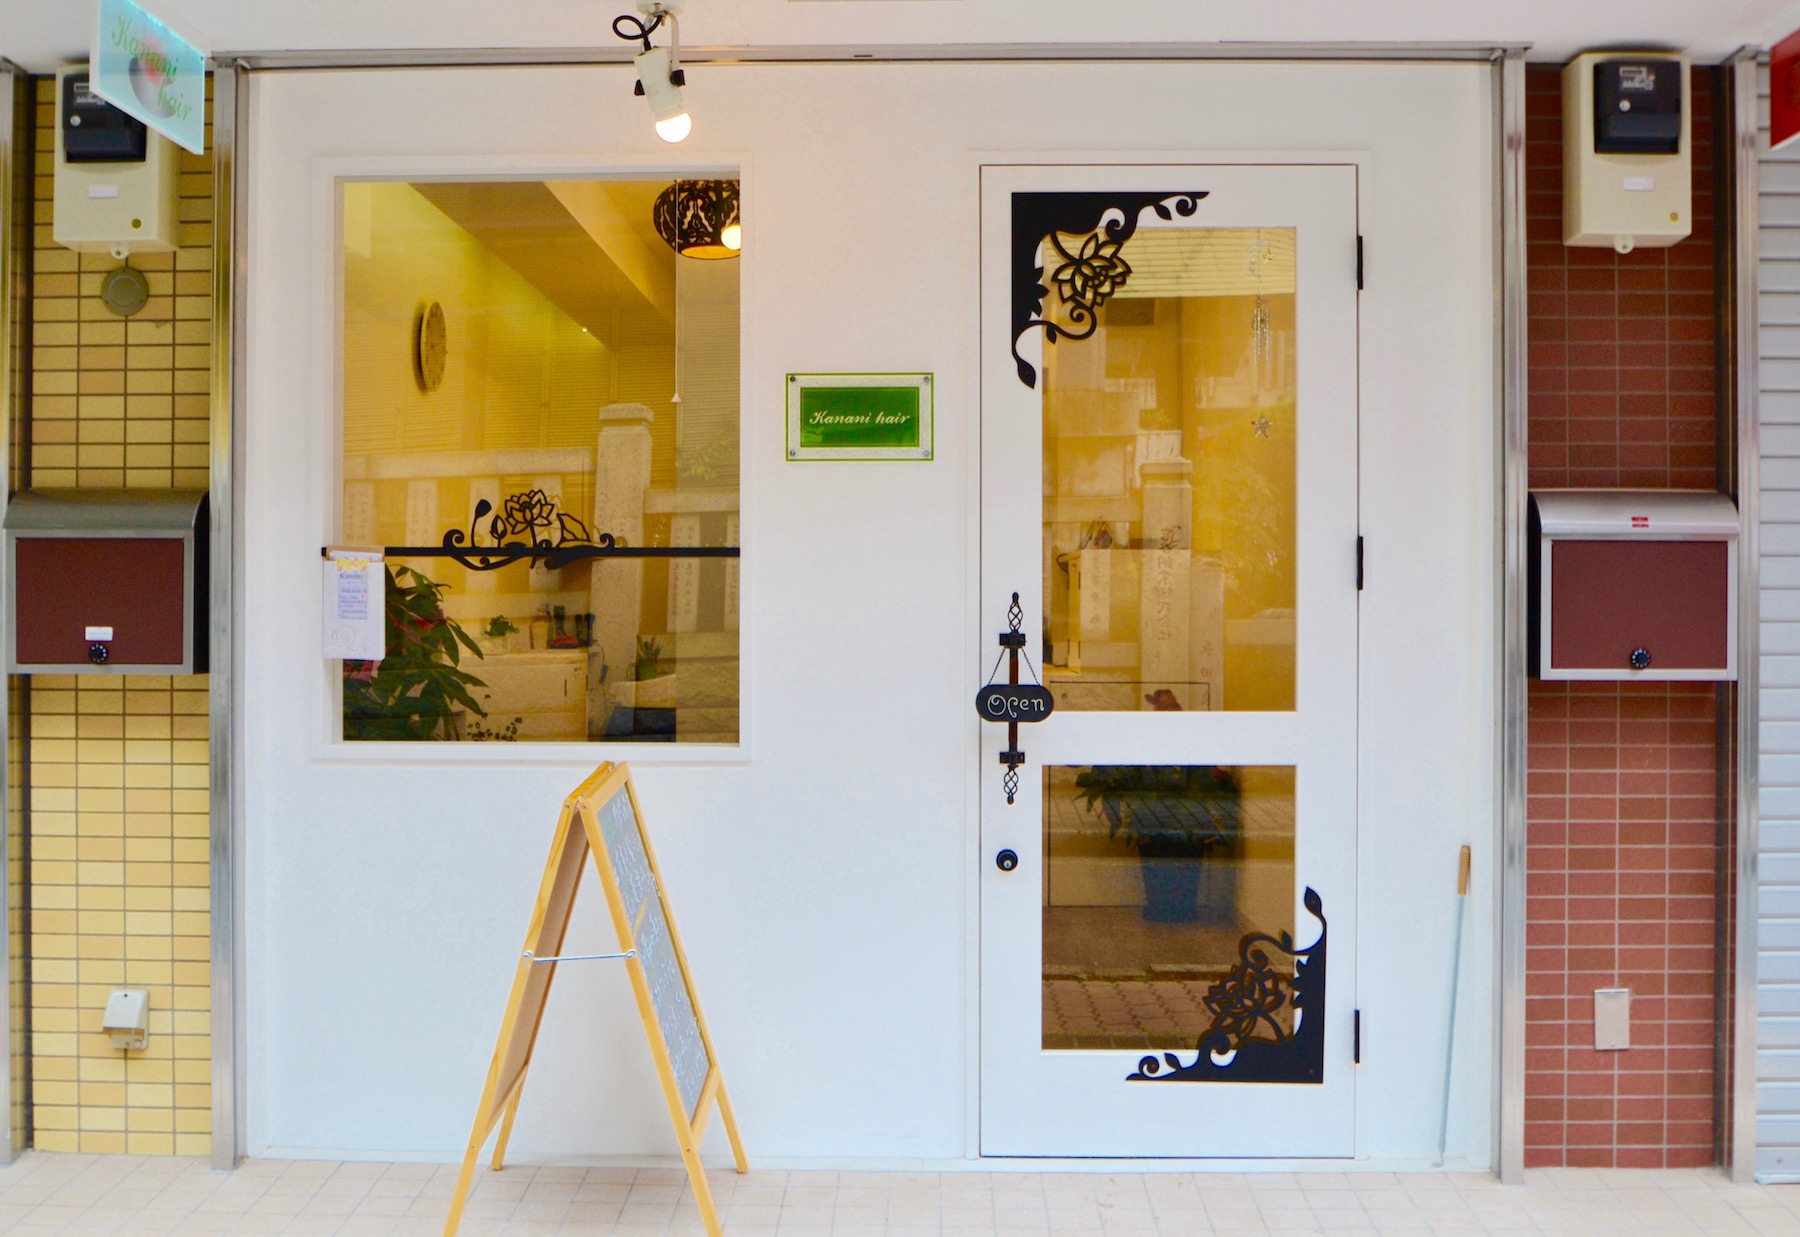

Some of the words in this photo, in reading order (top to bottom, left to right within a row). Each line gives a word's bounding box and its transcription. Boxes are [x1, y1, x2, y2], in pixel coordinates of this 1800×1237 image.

[112, 15, 180, 83] Kanani
[157, 84, 192, 121] hair
[809, 409, 871, 425] Kanani
[875, 410, 910, 425] hair
[987, 694, 1045, 719] Open
